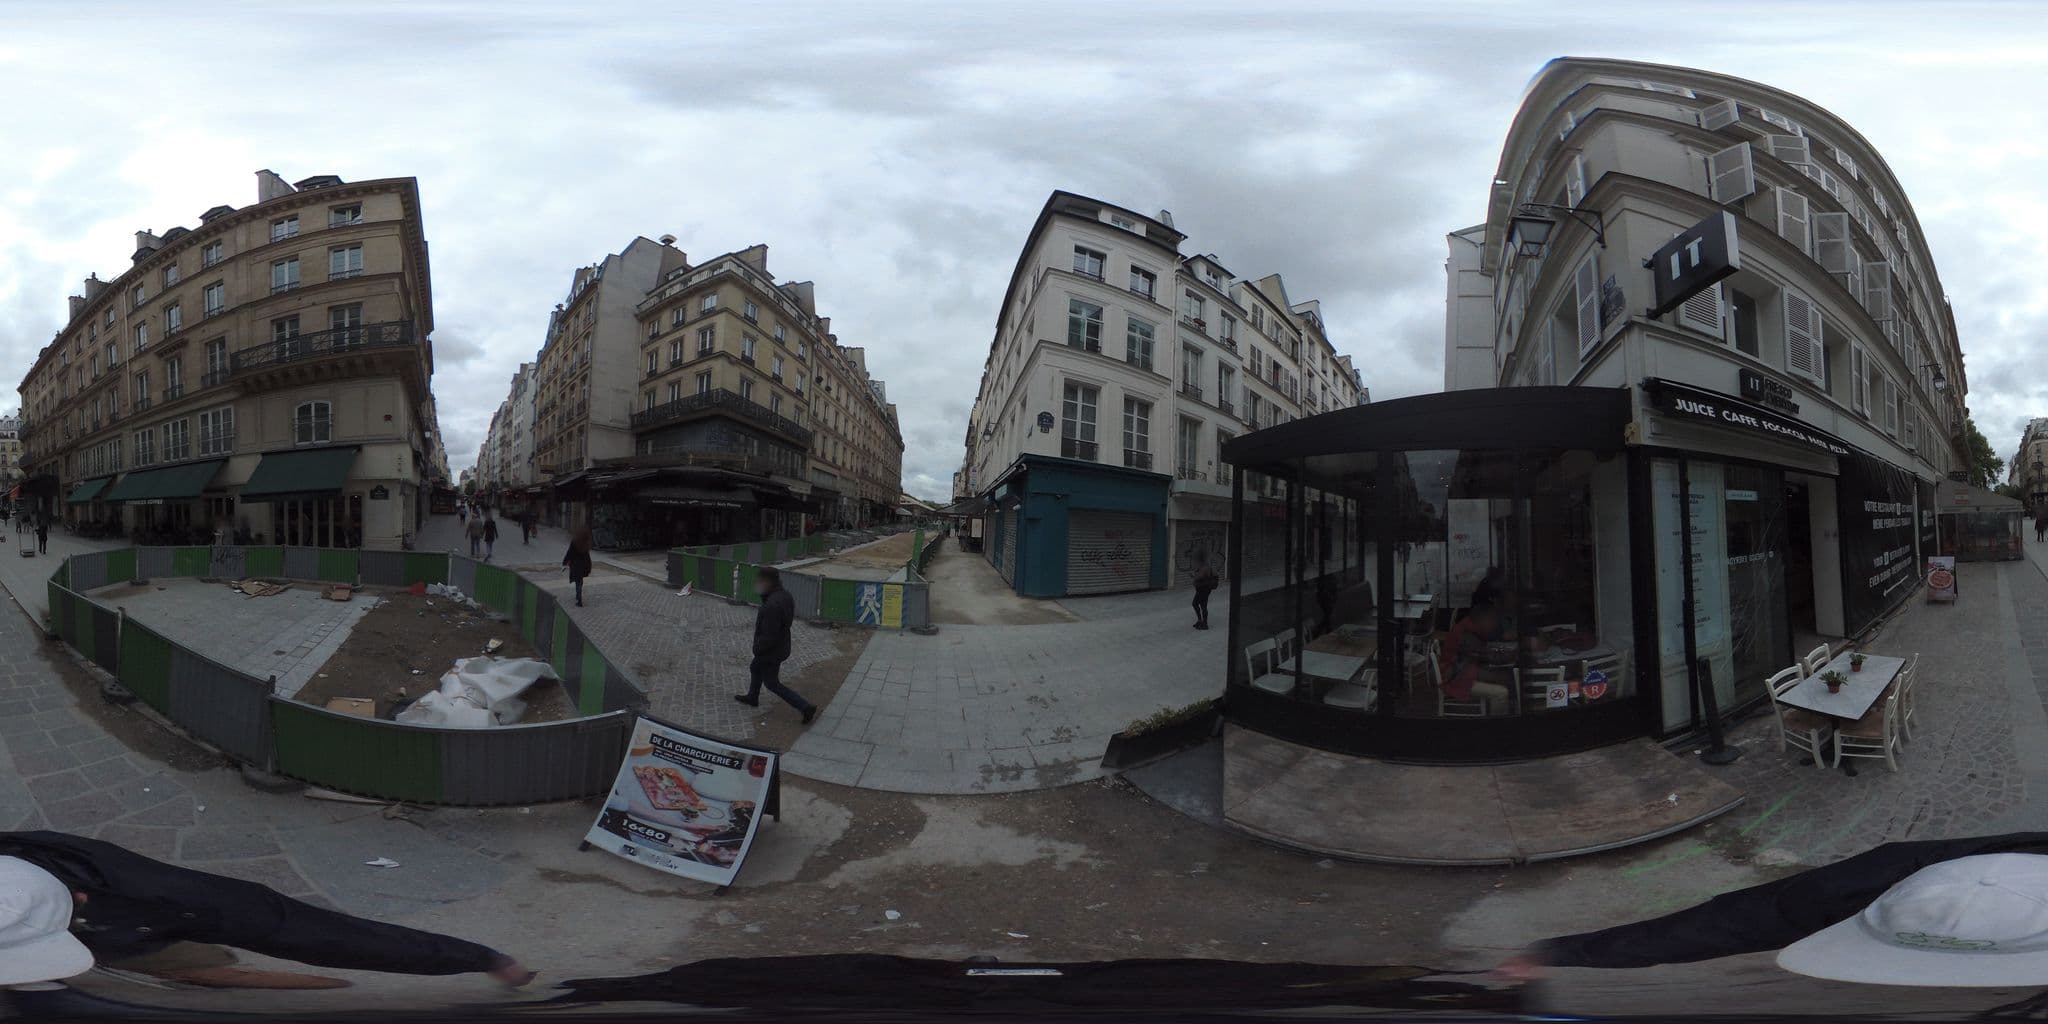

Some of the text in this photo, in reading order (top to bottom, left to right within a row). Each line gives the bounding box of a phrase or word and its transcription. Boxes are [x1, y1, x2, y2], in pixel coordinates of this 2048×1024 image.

[1670, 236, 1702, 281] IT
[1750, 377, 1760, 391] IT
[1675, 398, 1716, 418] JUICE
[1721, 410, 1758, 427] CAFFE
[1761, 420, 1807, 440] FOCACCIA
[652, 736, 661, 745] DE
[663, 739, 673, 750] LA
[674, 744, 731, 766] CHARCUTERIE
[734, 760, 740, 768] ?
